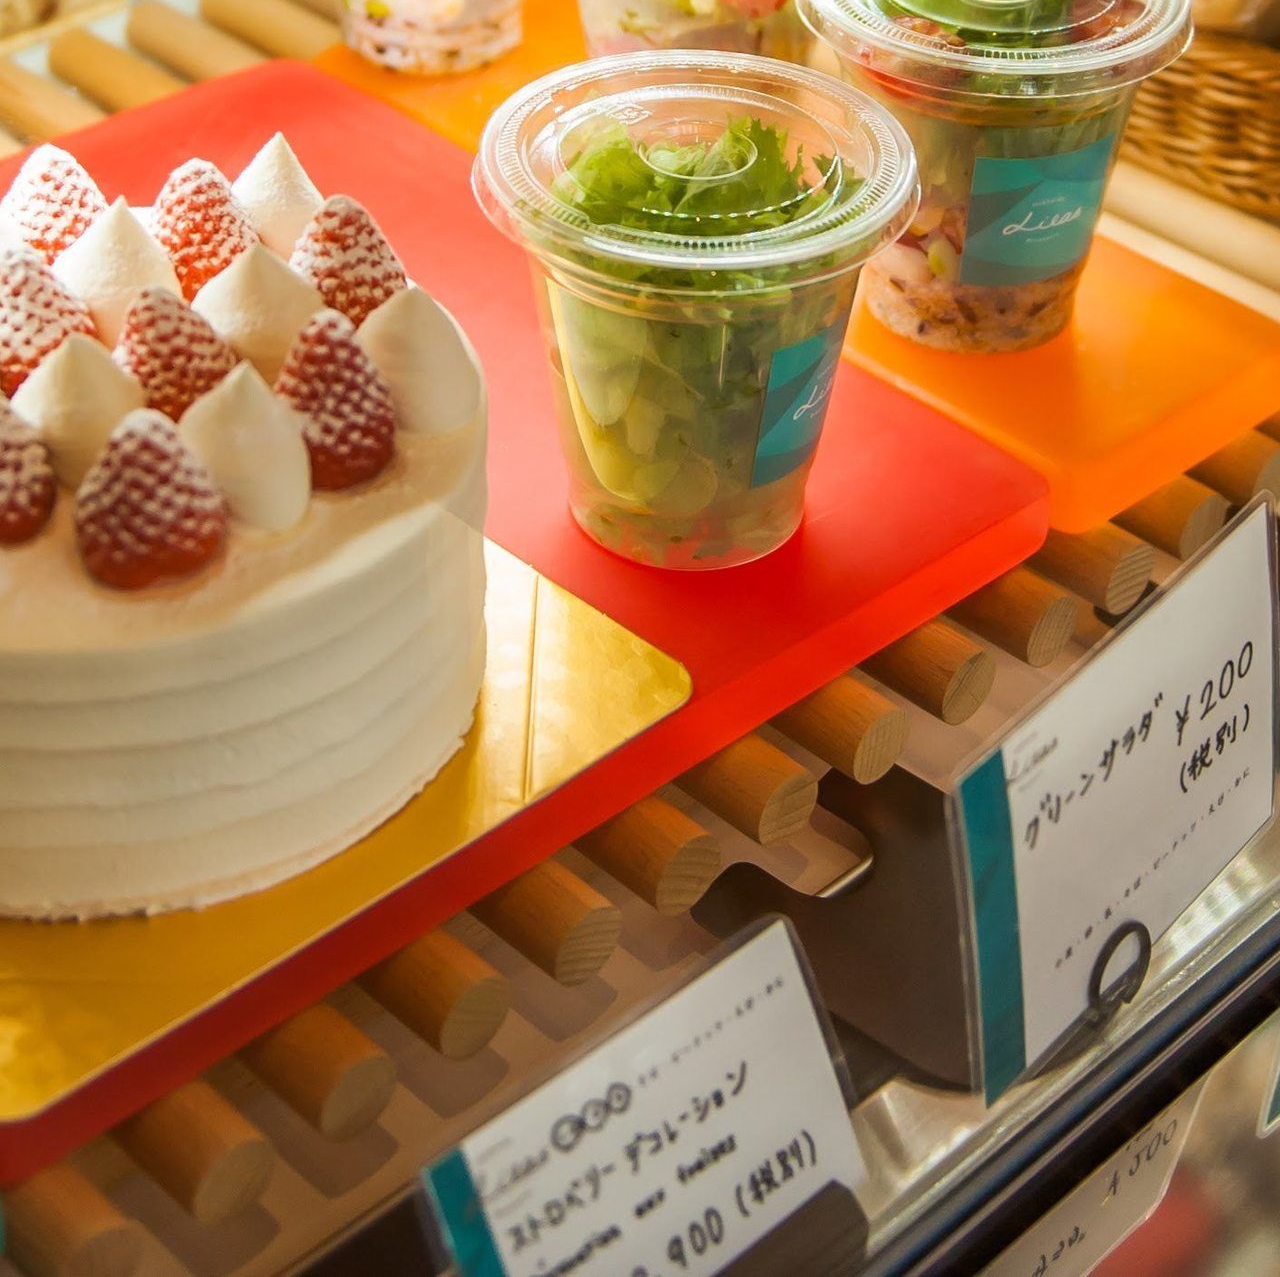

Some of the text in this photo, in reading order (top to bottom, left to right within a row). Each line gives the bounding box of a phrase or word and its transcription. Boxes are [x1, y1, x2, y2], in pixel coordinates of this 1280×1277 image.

[1002, 205, 1083, 236] Lilas
[1024, 640, 1254, 850] グリーンサラダ ¥200
